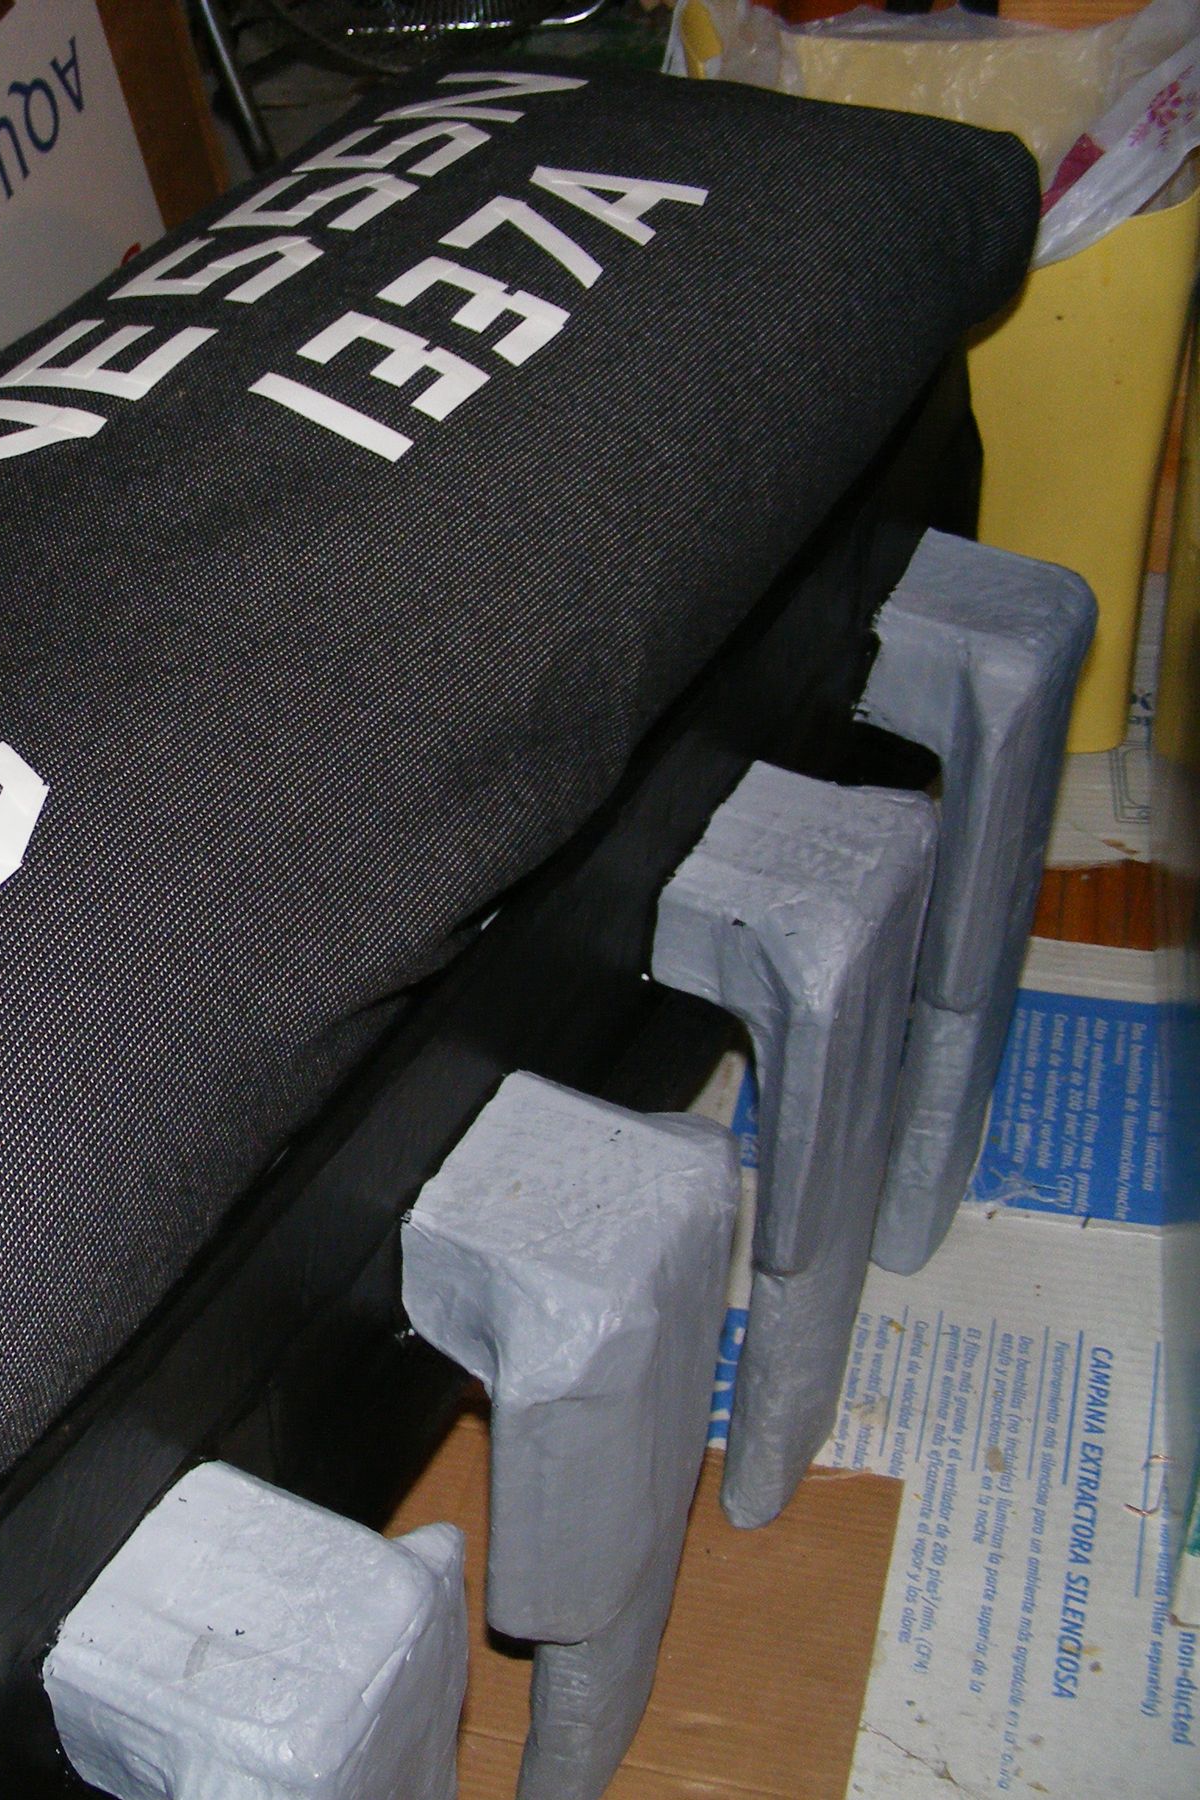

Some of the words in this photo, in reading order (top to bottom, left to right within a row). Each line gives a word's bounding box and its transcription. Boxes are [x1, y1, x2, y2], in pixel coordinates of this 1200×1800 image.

[248, 166, 708, 463] 1337A
[1048, 1053, 1062, 1066] de
[1069, 1071, 1084, 1086] de
[1066, 1088, 1083, 1110] 200
[1123, 1098, 1138, 1112] de
[909, 1319, 929, 1358] Control
[942, 1324, 962, 1372] permiten
[965, 1327, 981, 1339] El
[995, 1332, 1015, 1366] estufa
[1016, 1335, 1033, 1355] Dos
[906, 1360, 922, 1374] de
[958, 1339, 980, 1369] filtro
[935, 1375, 956, 1421] eliminar
[957, 1370, 974, 1394] más
[1009, 1357, 1030, 1410] bombillas
[1043, 1340, 1070, 1424] Funcionamiento
[1081, 1345, 1115, 1435] CAMPANA
[896, 1376, 919, 1430] velocidad
[948, 1395, 971, 1434] grande
[931, 1423, 948, 1447] más
[1004, 1413, 1023, 1434] (no
[1041, 1426, 1059, 1449] más
[887, 1431, 909, 1477] variable
[947, 1448, 963, 1461] el
[918, 1449, 945, 1520] eficazmente
[937, 1462, 959, 1521] ventilador
[980, 1475, 994, 1490] en
[1066, 1441, 1104, 1566] EXTRACTORA
[916, 1521, 934, 1535] el
[934, 1523, 951, 1539] de
[971, 1509, 990, 1545] noche
[991, 1497, 1012, 1548] iluminan
[1028, 1507, 1047, 1535] para
[907, 1535, 927, 1570] vapor
[929, 1541, 948, 1566] 200
[988, 1551, 1004, 1565] la
[1028, 1537, 1042, 1553] un
[904, 1584, 921, 1604] los
[980, 1566, 1001, 1602] parte
[1020, 1557, 1042, 1614] ambiente
[896, 1606, 918, 1645] olores
[972, 1603, 996, 1655] superior
[1016, 1617, 1035, 1644] más
[1151, 1602, 1169, 1635] filter
[1051, 1571, 1090, 1700] SILENCIOSA
[971, 1658, 989, 1677] de
[1140, 1640, 1166, 1718] separately)
[1169, 1631, 1197, 1745] non-ducted
